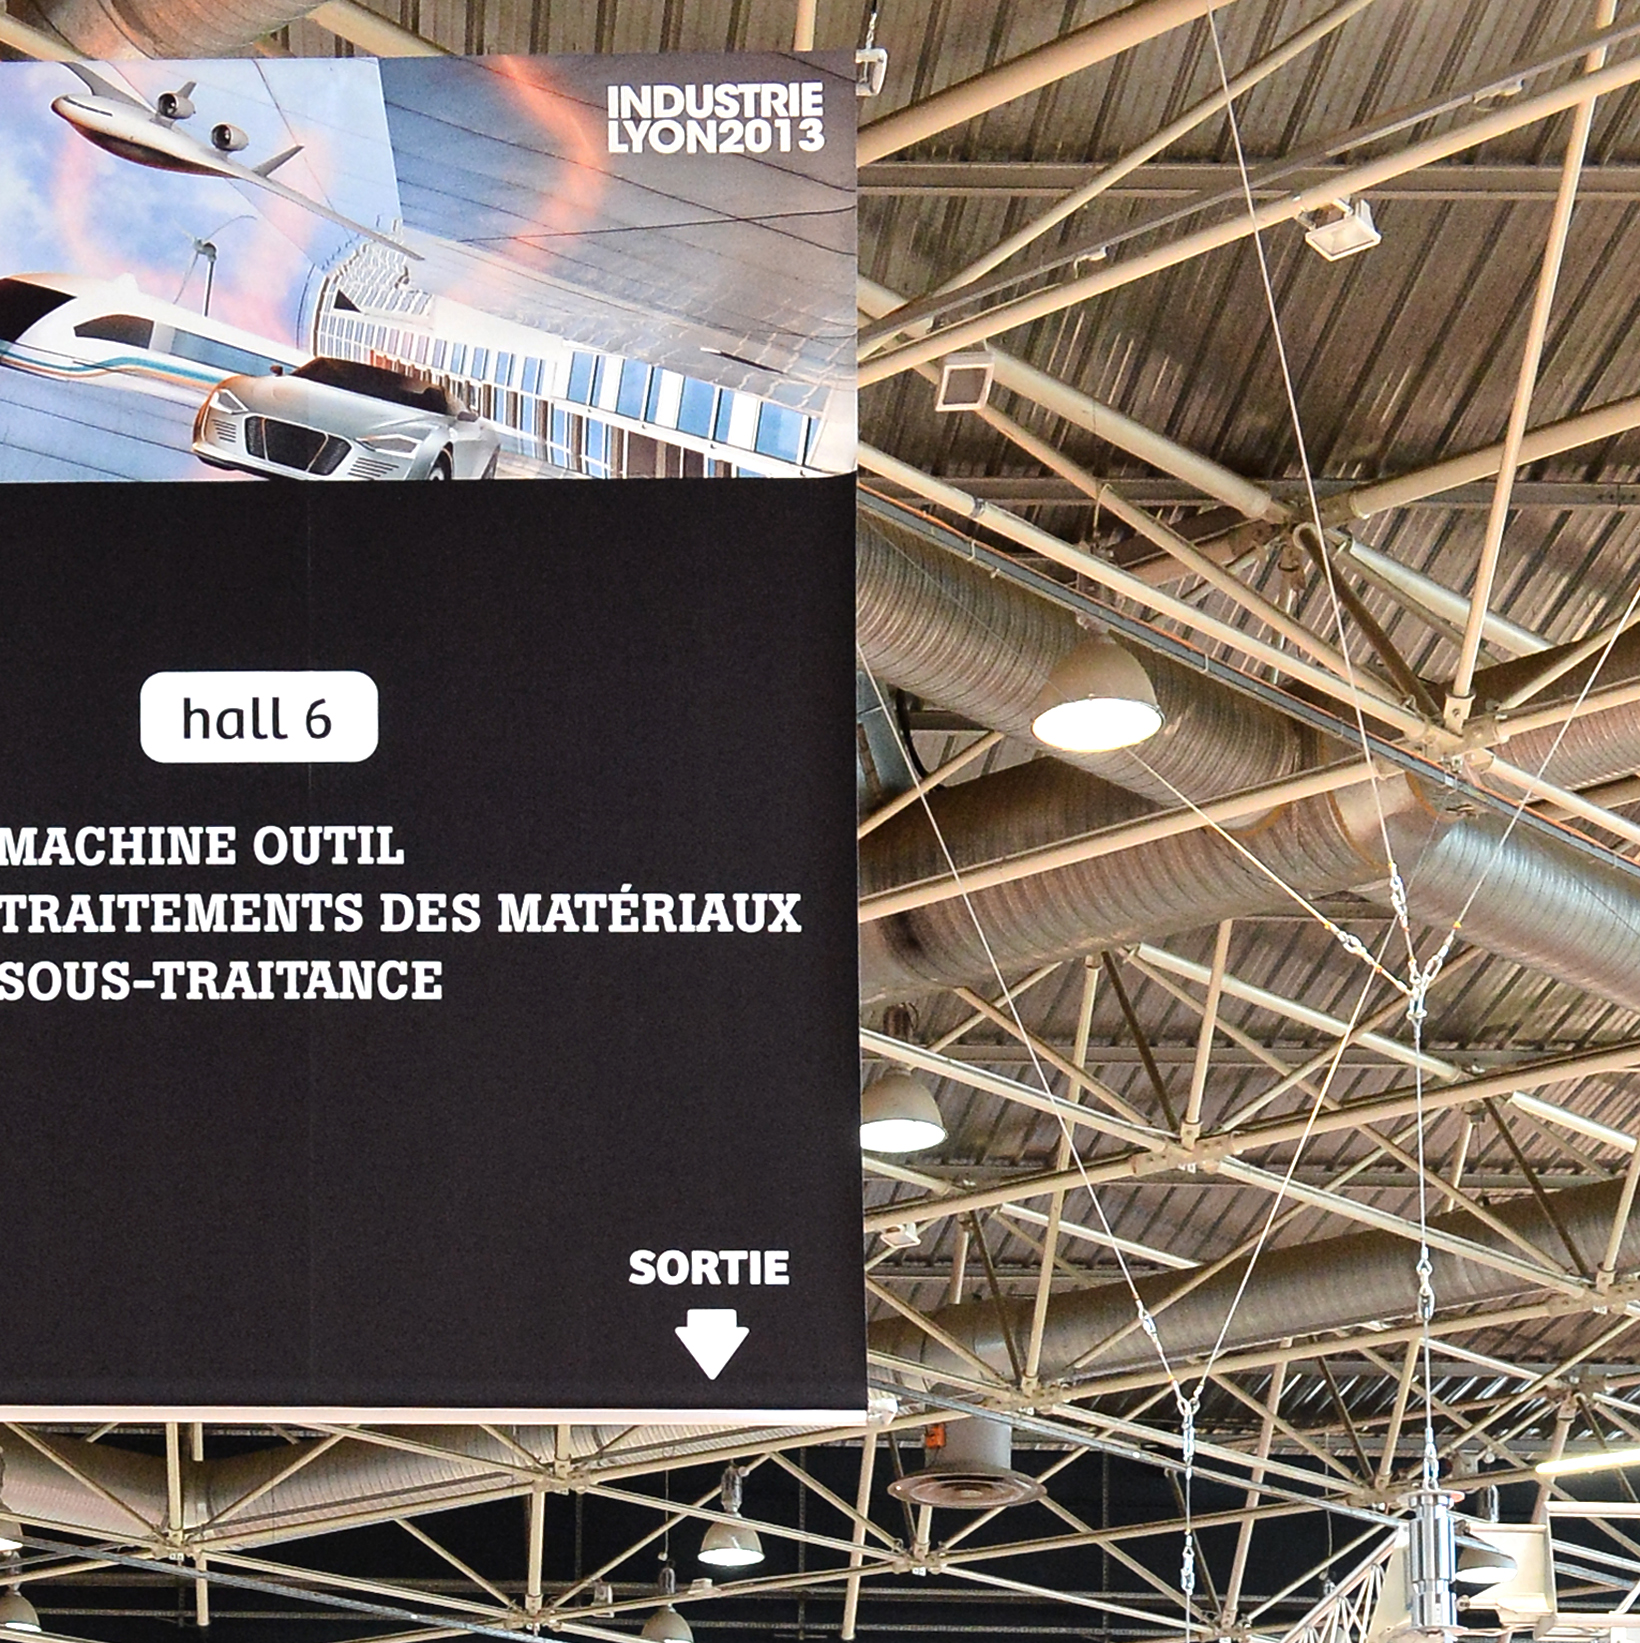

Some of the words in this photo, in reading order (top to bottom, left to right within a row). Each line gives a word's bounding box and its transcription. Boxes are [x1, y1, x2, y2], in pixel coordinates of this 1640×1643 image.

[605, 82, 824, 119] INDUSTRIE
[606, 117, 826, 155] LYON2013
[181, 697, 289, 741] hall
[304, 698, 333, 741] 6
[253, 826, 405, 866] OUTIL
[379, 893, 481, 933] DES
[497, 883, 803, 933] MATÉRIAUX
[627, 1249, 790, 1287] SORTIE
